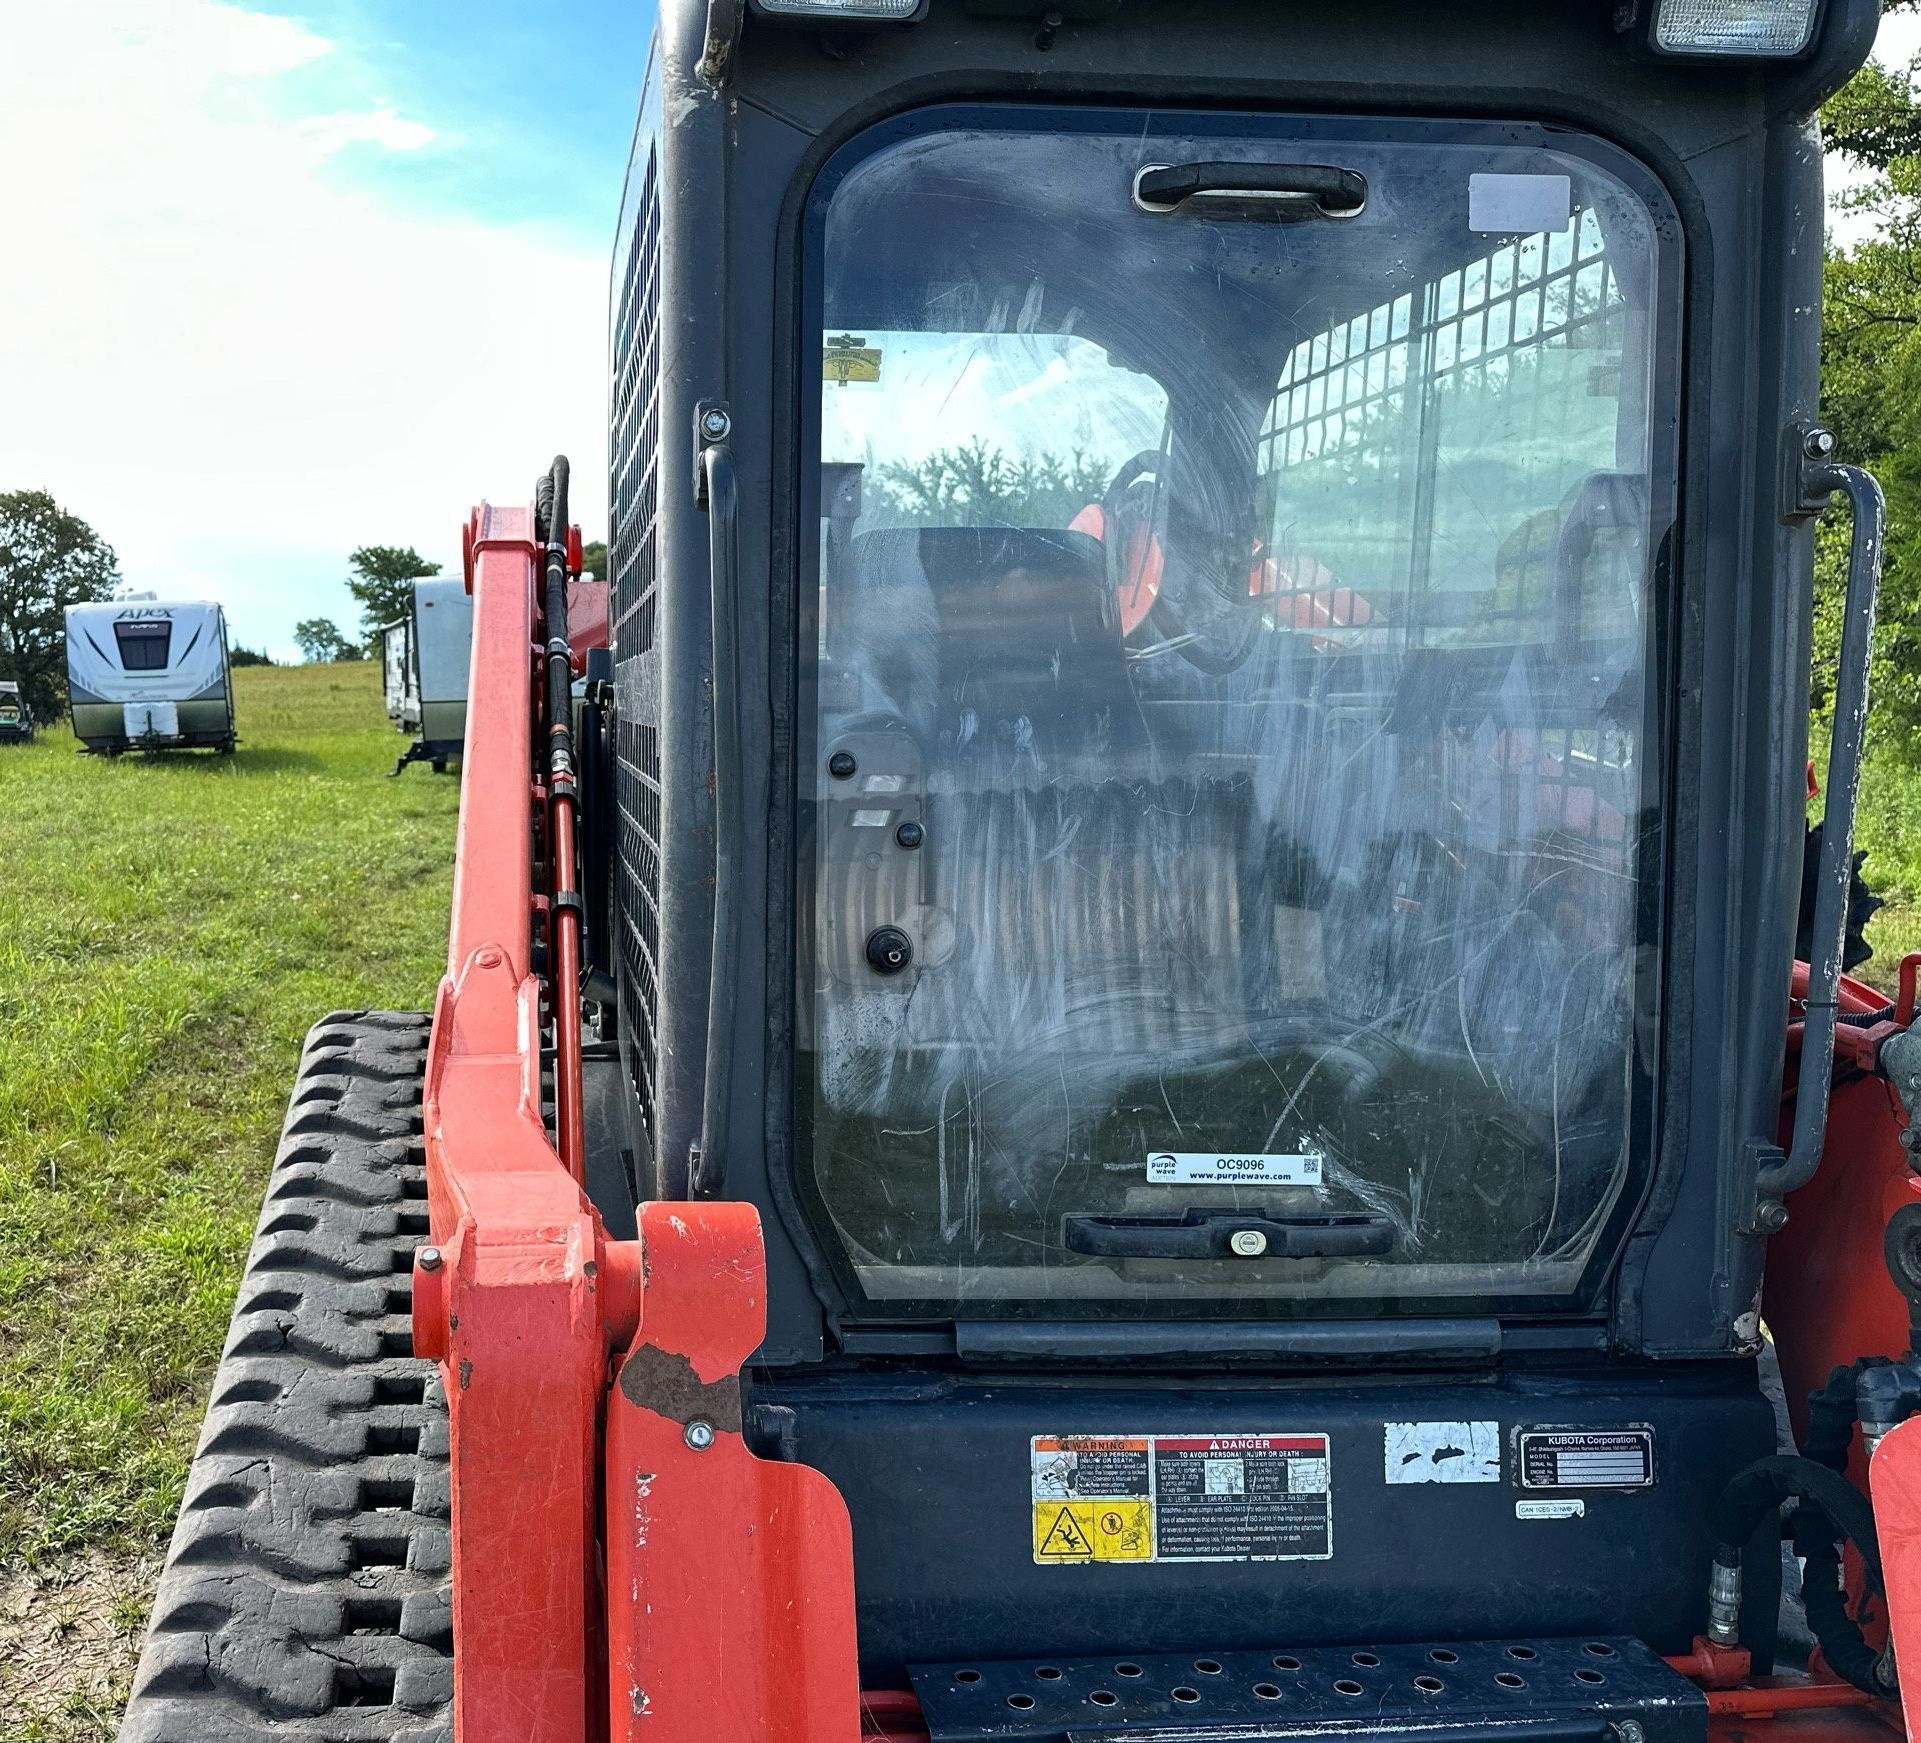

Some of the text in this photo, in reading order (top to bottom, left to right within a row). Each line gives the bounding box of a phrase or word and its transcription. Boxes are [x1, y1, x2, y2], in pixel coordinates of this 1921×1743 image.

[1151, 1161, 1176, 1169] purple
[1216, 1159, 1265, 1170] OC9096
[1189, 1171, 1291, 1181] www.purplewave.com
[1222, 1440, 1270, 1449] DANGER
[1548, 1436, 1637, 1445] KUBOTA Corporation
[1073, 1441, 1125, 1450] WARNING
